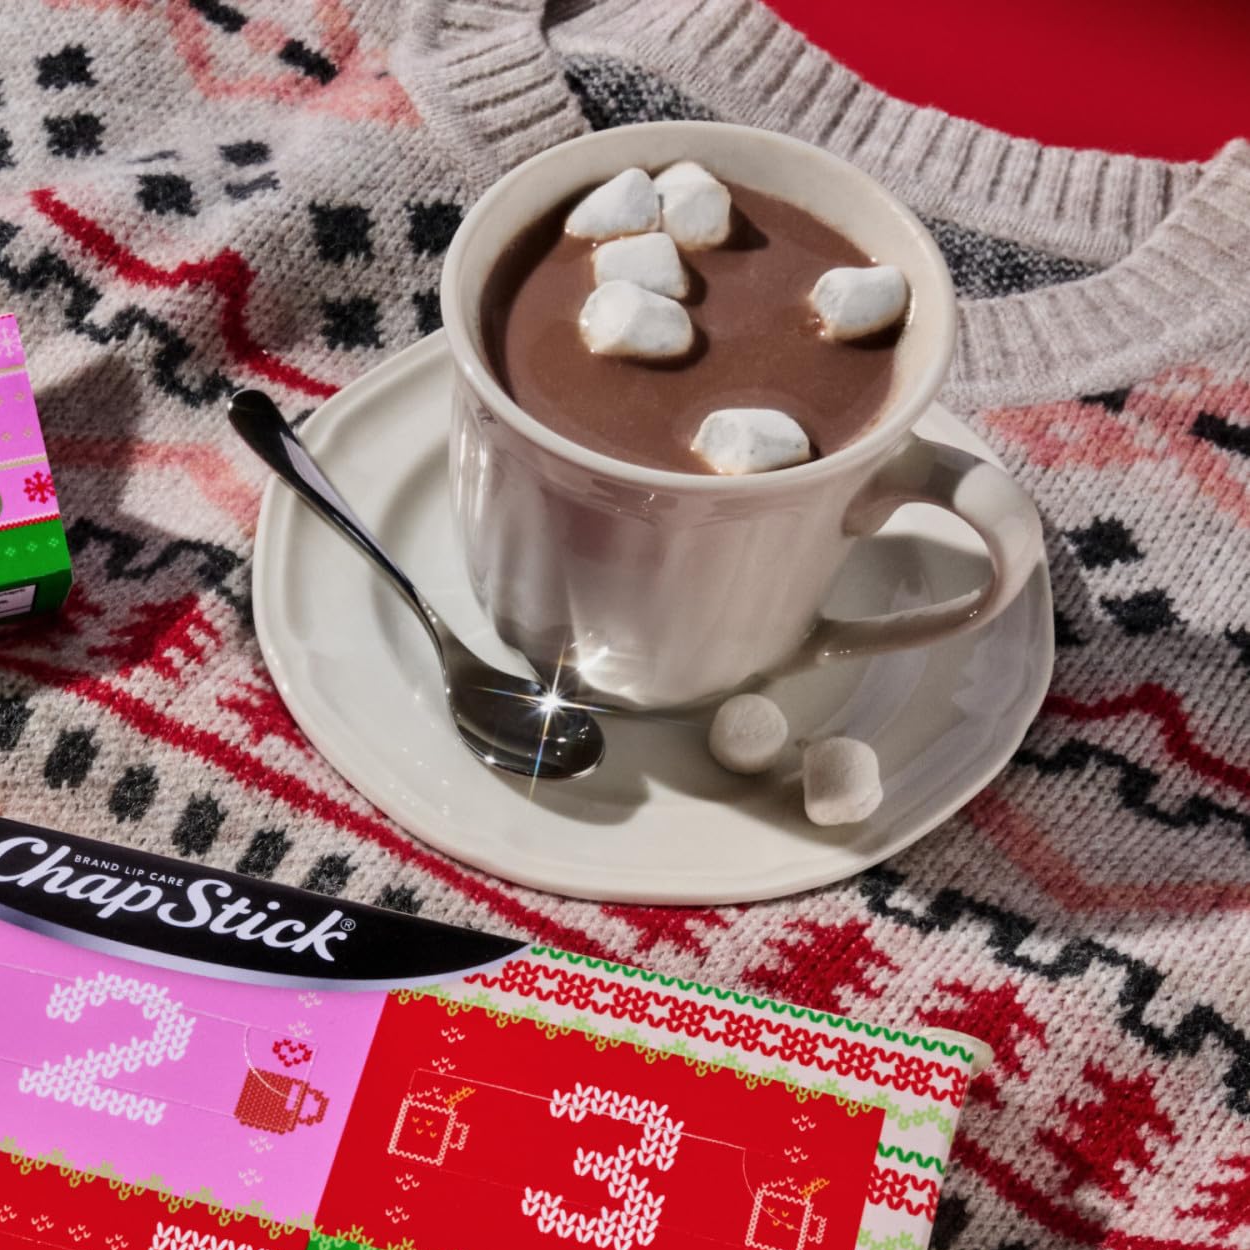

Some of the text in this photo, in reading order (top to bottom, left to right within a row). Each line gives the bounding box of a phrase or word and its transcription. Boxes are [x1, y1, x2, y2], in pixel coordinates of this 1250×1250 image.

[73, 853, 185, 888] BRAND LIP CARE
[18, 972, 196, 1126] 2
